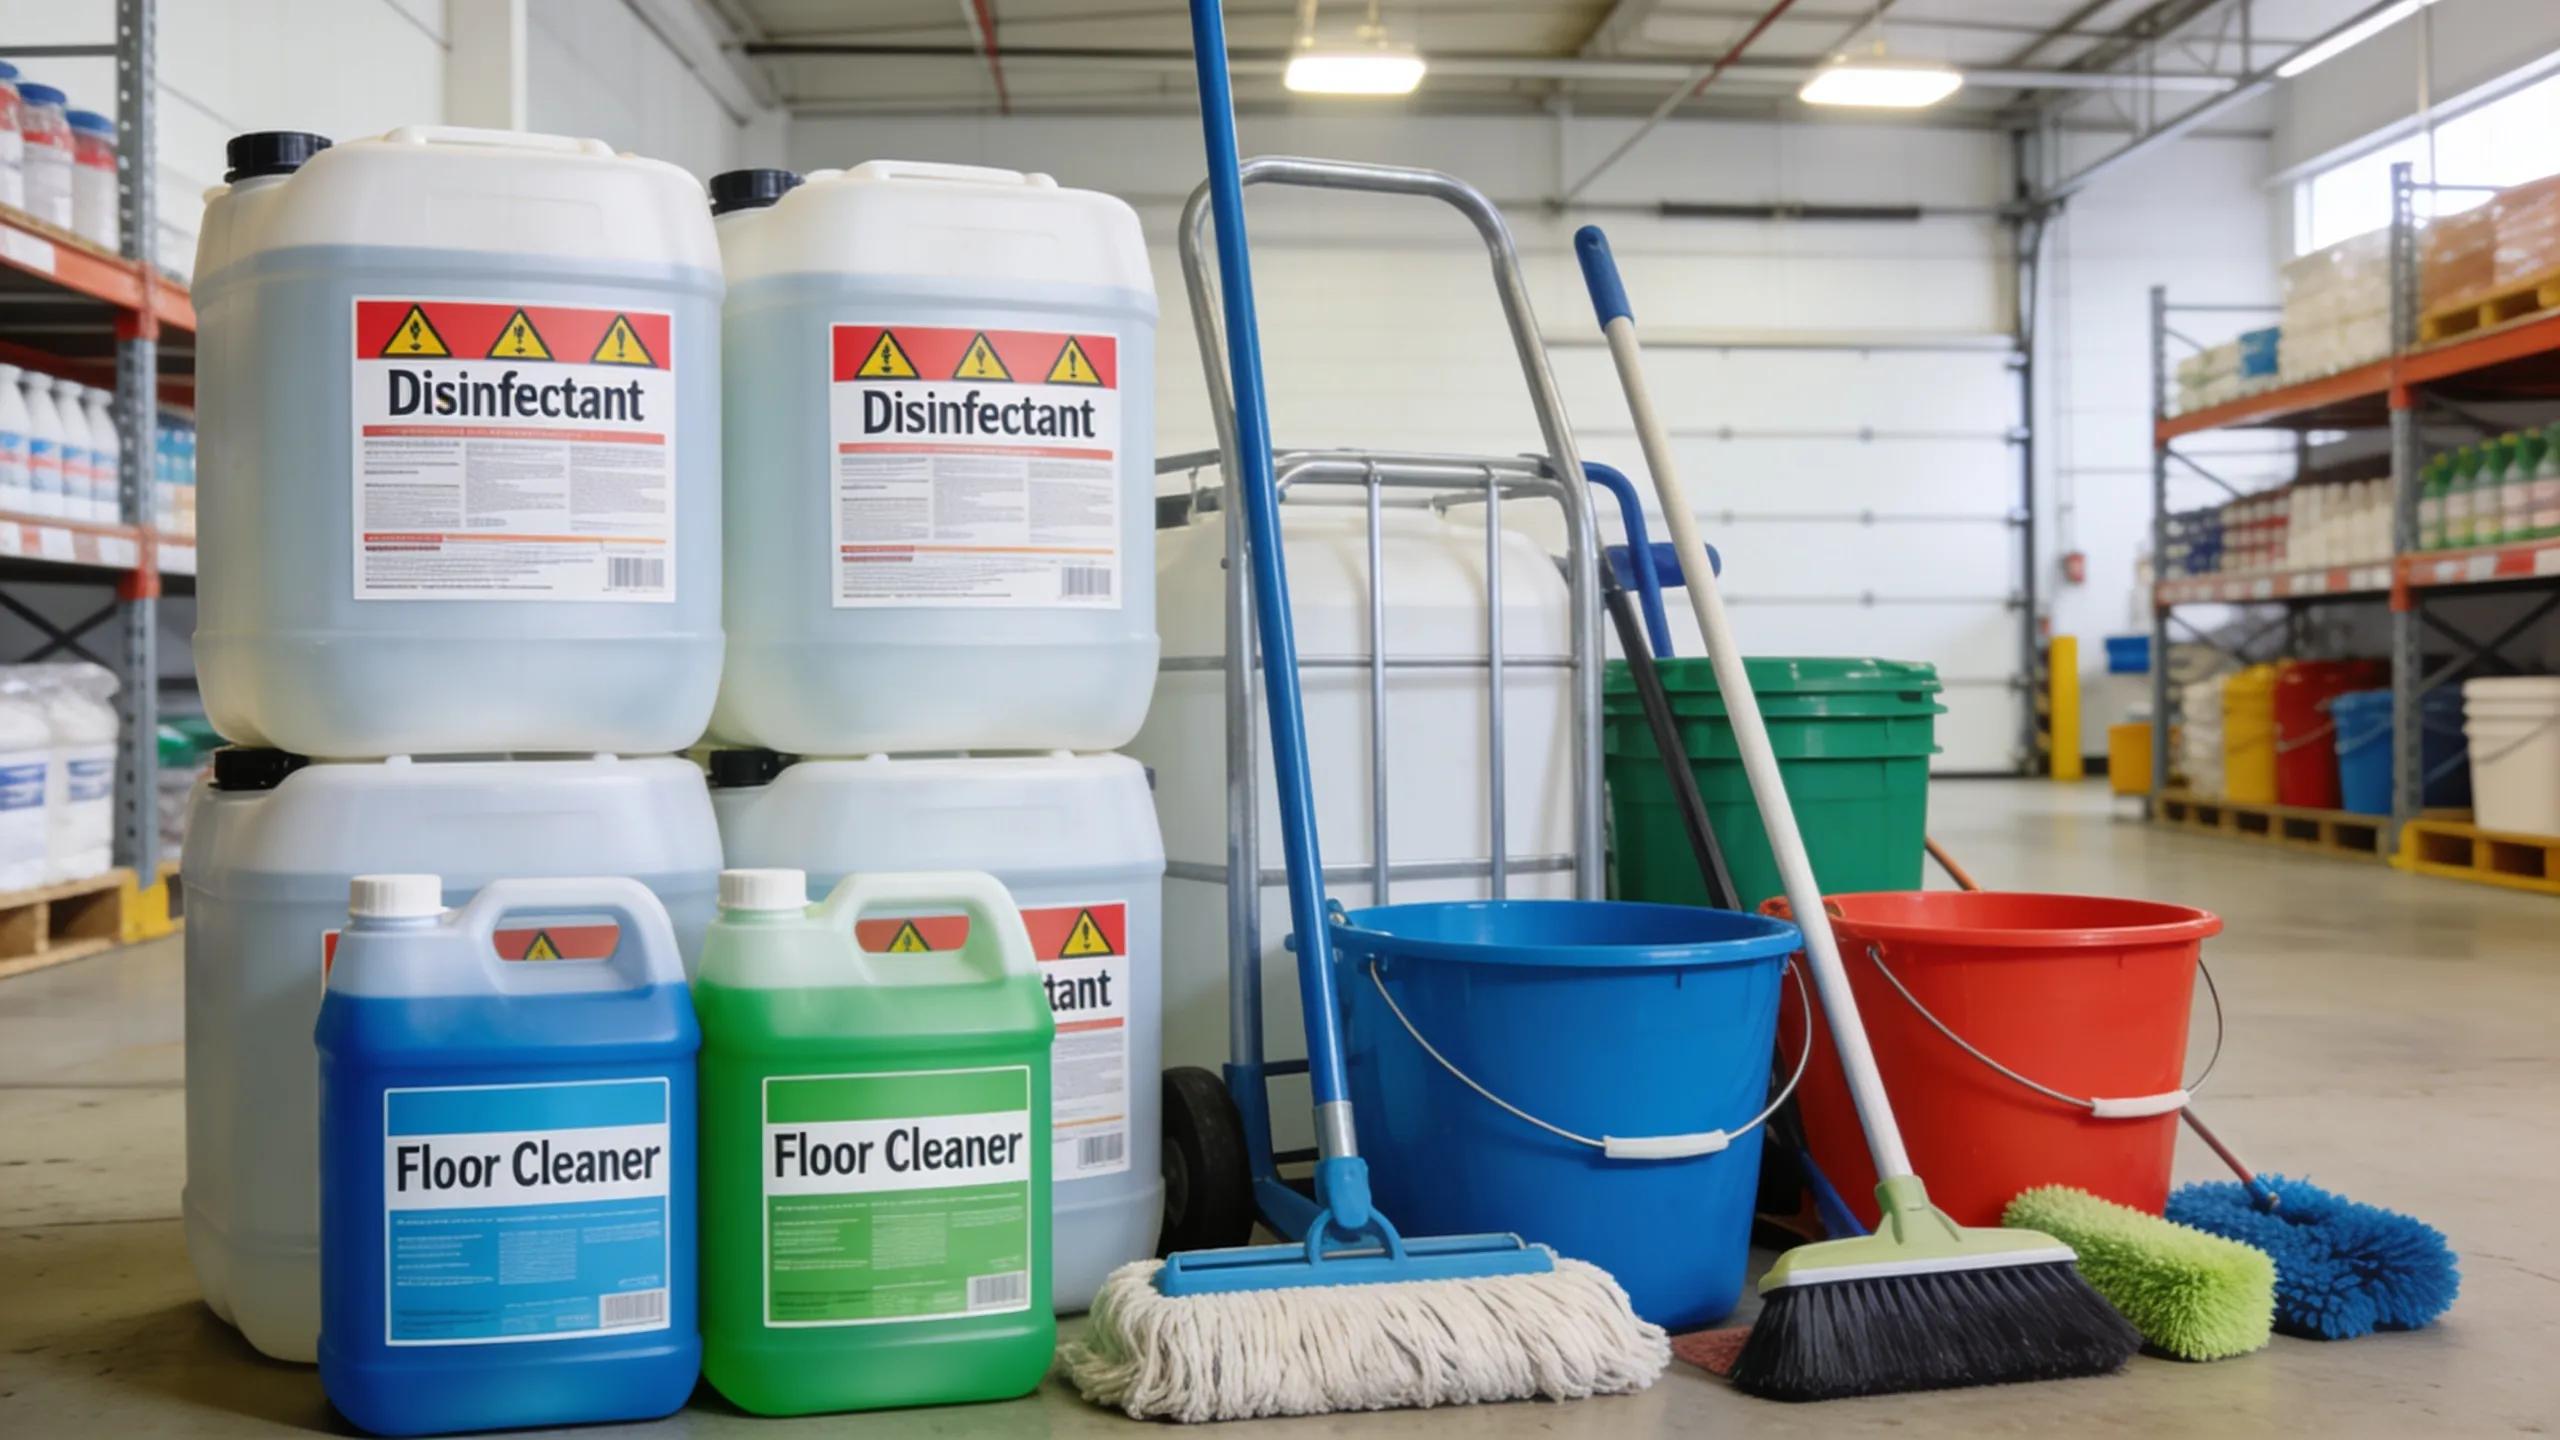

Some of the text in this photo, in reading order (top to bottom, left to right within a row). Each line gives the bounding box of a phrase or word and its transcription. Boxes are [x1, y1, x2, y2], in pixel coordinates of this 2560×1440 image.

[388, 369, 645, 421] Disinfectant
[863, 390, 1096, 438] Disinfectant
[396, 1139, 661, 1192] Floor Cleaner
[775, 1126, 1024, 1178] Floor Cleaner
